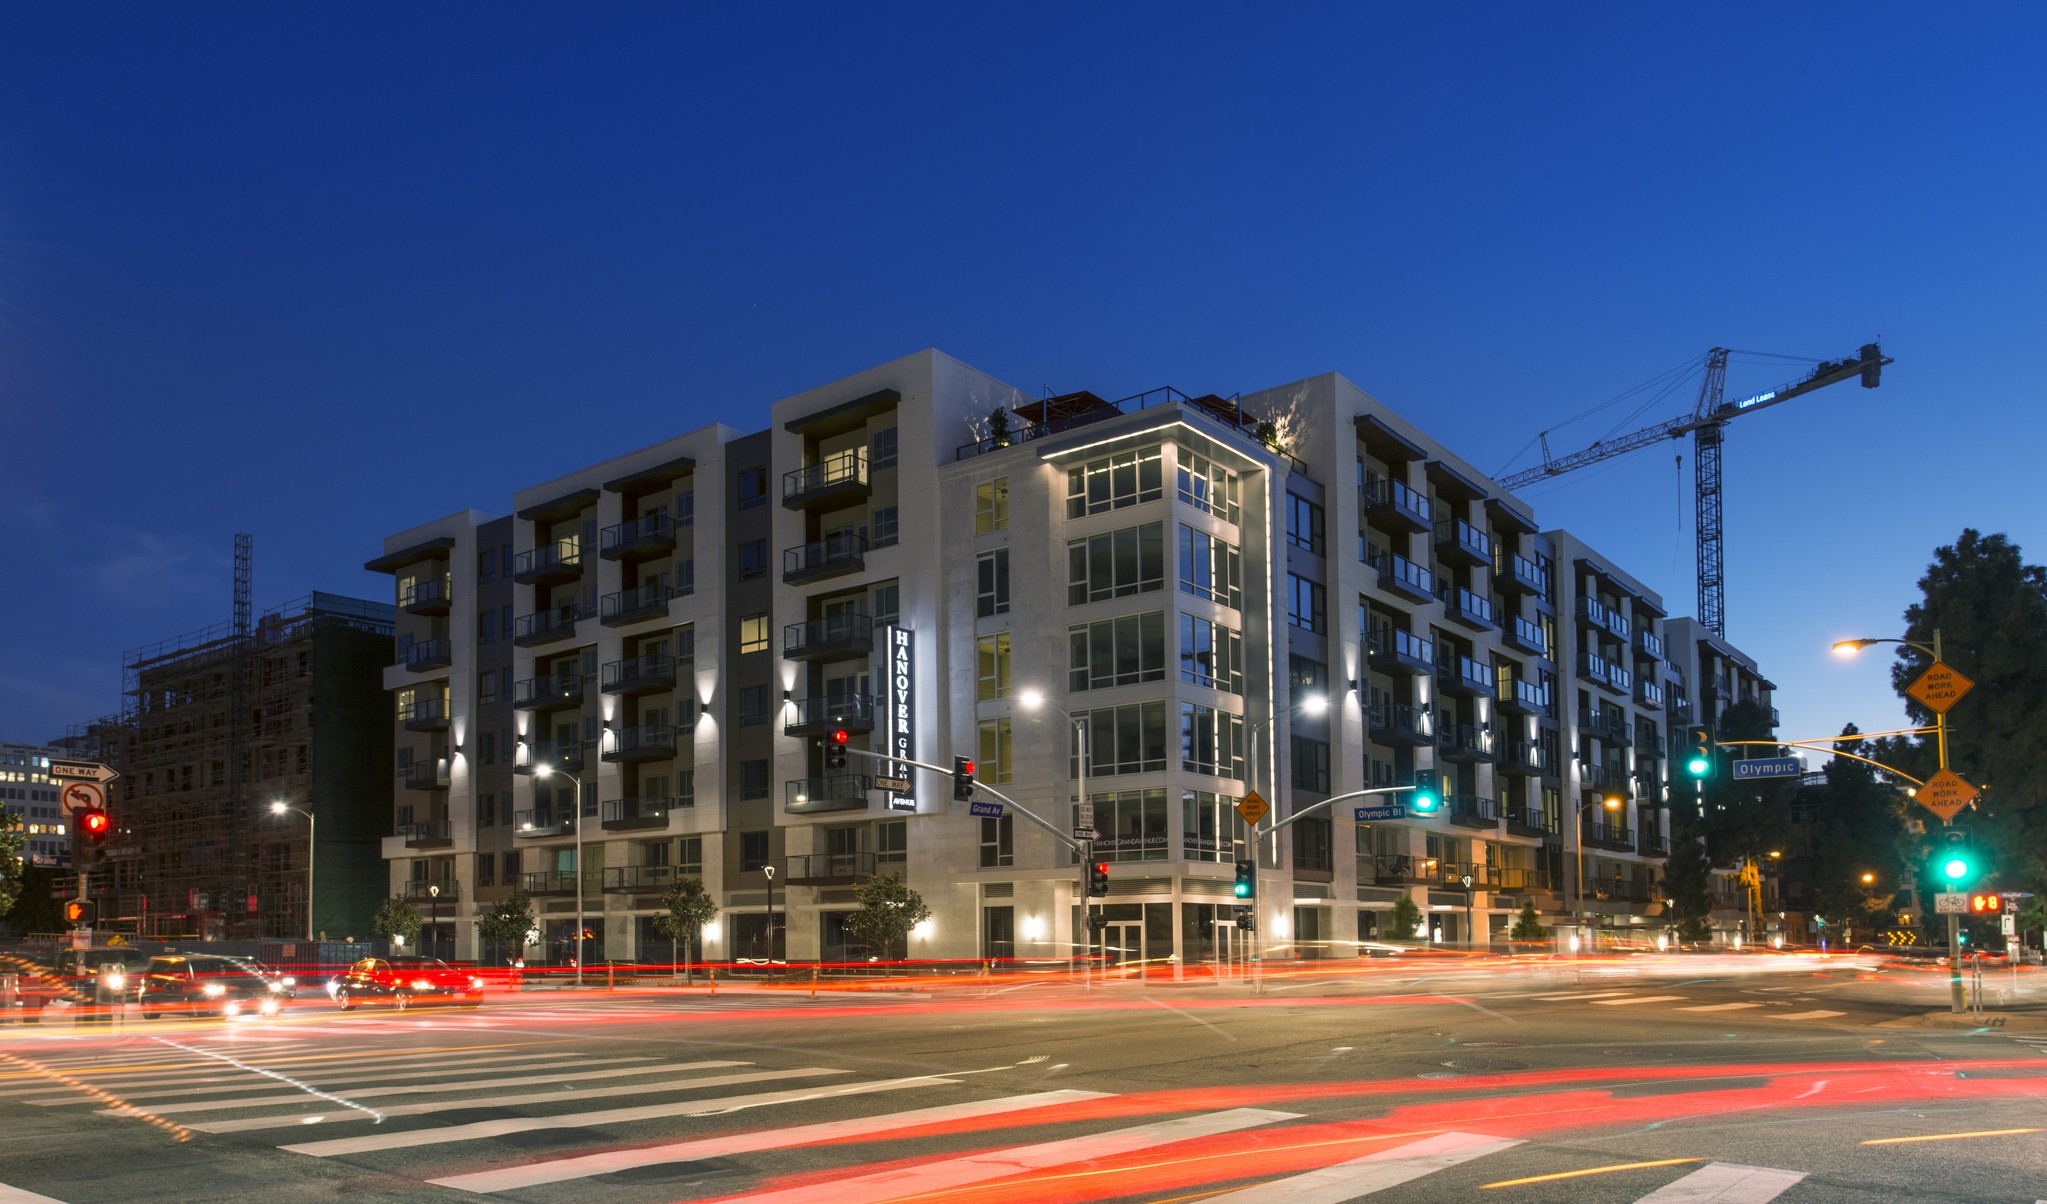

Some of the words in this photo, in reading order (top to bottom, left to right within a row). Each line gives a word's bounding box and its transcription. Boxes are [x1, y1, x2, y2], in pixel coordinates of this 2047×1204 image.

[895, 630, 909, 734] HANOVER
[1927, 673, 1952, 681] ROAD
[1928, 682, 1952, 690] WORK
[1926, 691, 1956, 700] AHEAD
[55, 766, 75, 775] ONE
[77, 768, 97, 777] WAY
[1740, 763, 1794, 776] Olympic
[877, 779, 888, 787] ONE
[892, 781, 904, 789] WAY
[1932, 780, 1958, 788] ROAD
[1933, 790, 1959, 798] WORK
[893, 797, 915, 807] AVENUE
[1931, 799, 1962, 807] AHEAD
[973, 804, 991, 814] Grand
[992, 806, 1001, 815] Av
[1358, 808, 1390, 819] Olympic
[1392, 807, 1402, 816] Bl
[1093, 836, 1168, 847] HANOVEGRANDAVNUE.COM
